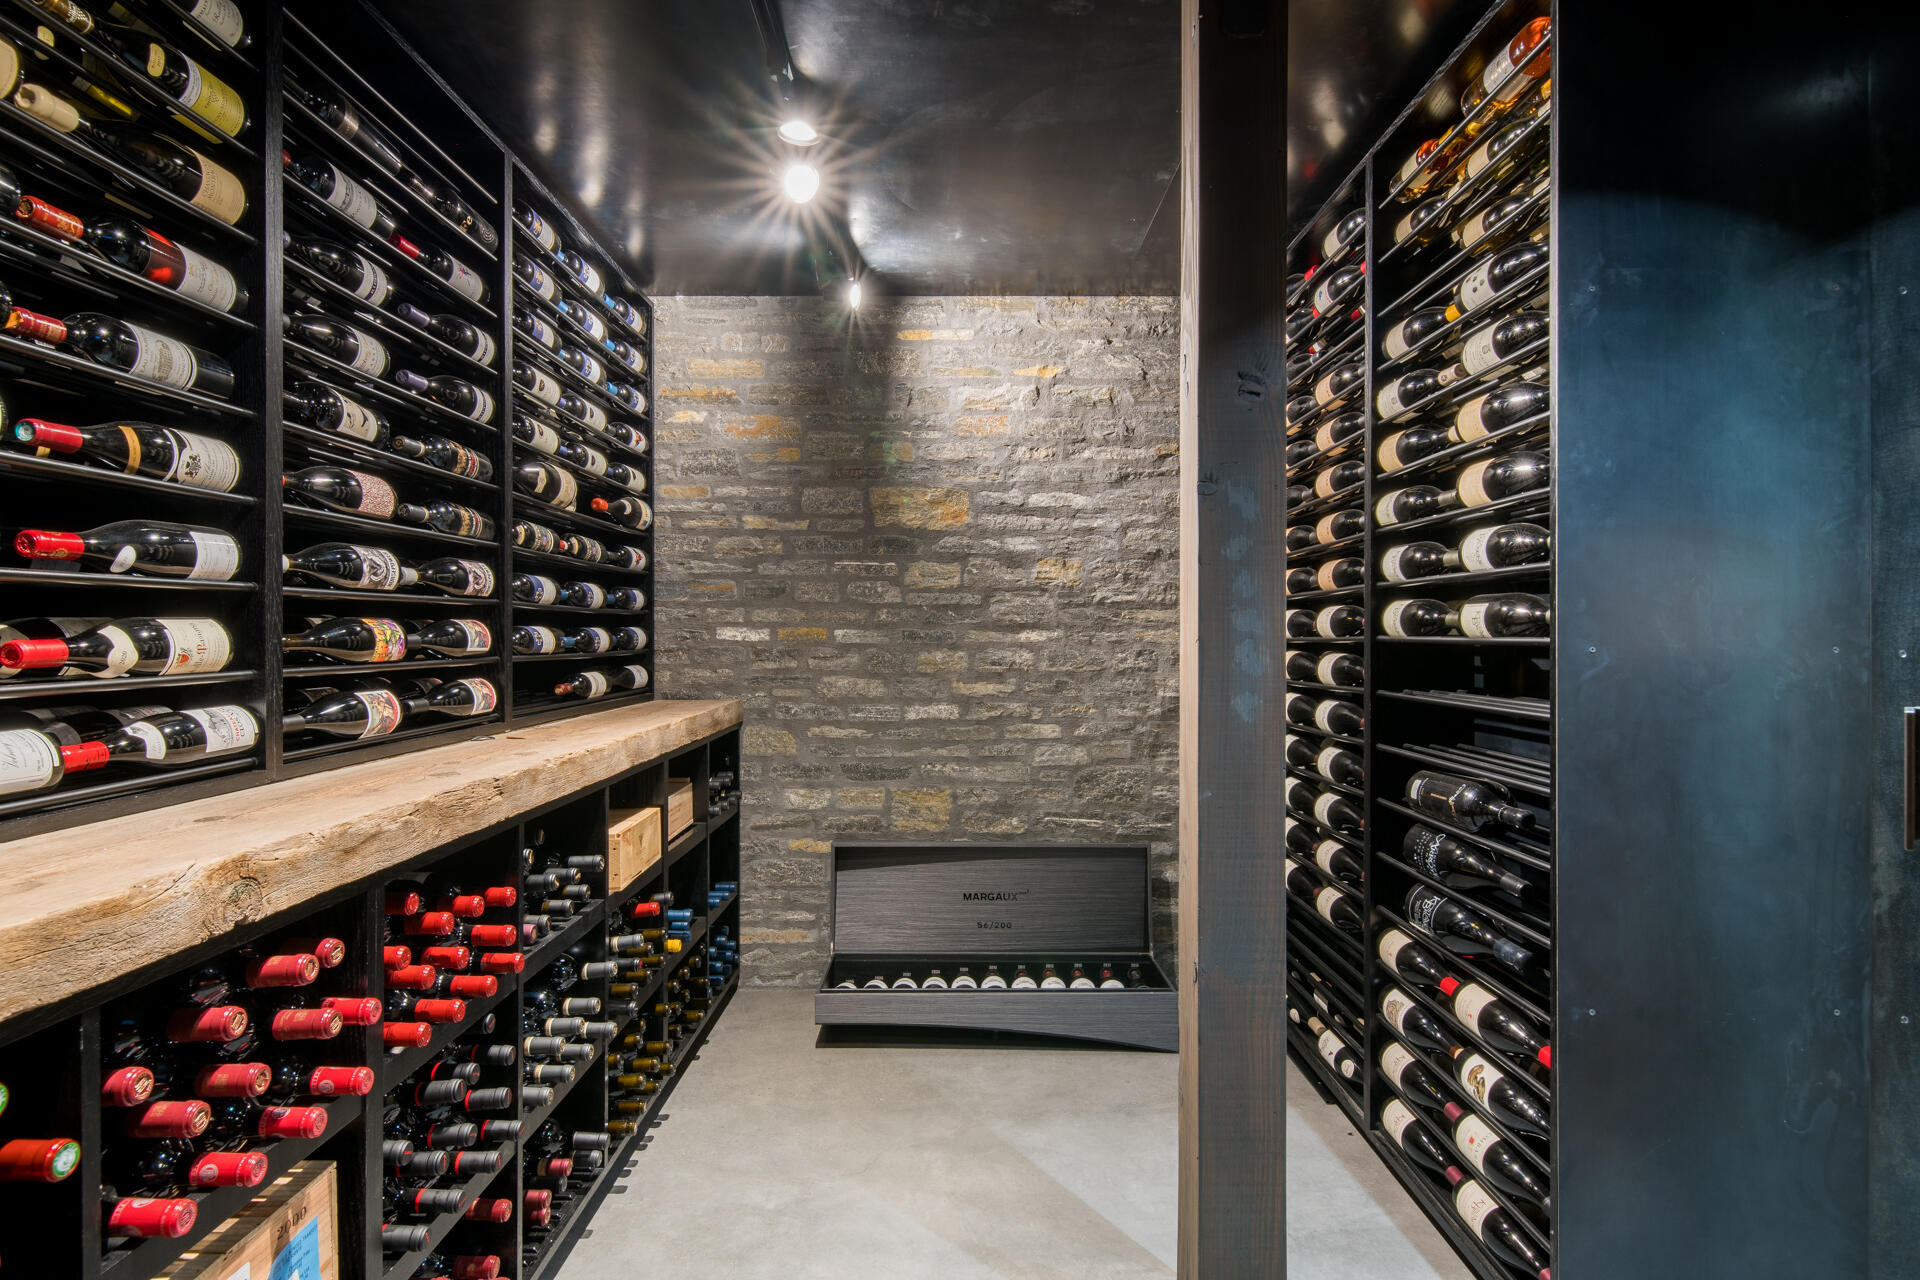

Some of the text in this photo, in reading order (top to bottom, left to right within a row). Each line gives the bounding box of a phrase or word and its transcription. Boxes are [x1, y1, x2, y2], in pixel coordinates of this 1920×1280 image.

[118, 649, 128, 666] 2020
[963, 892, 1018, 902] MARGAUX
[977, 921, 1013, 930] 56/200
[276, 1206, 308, 1241] 2000
